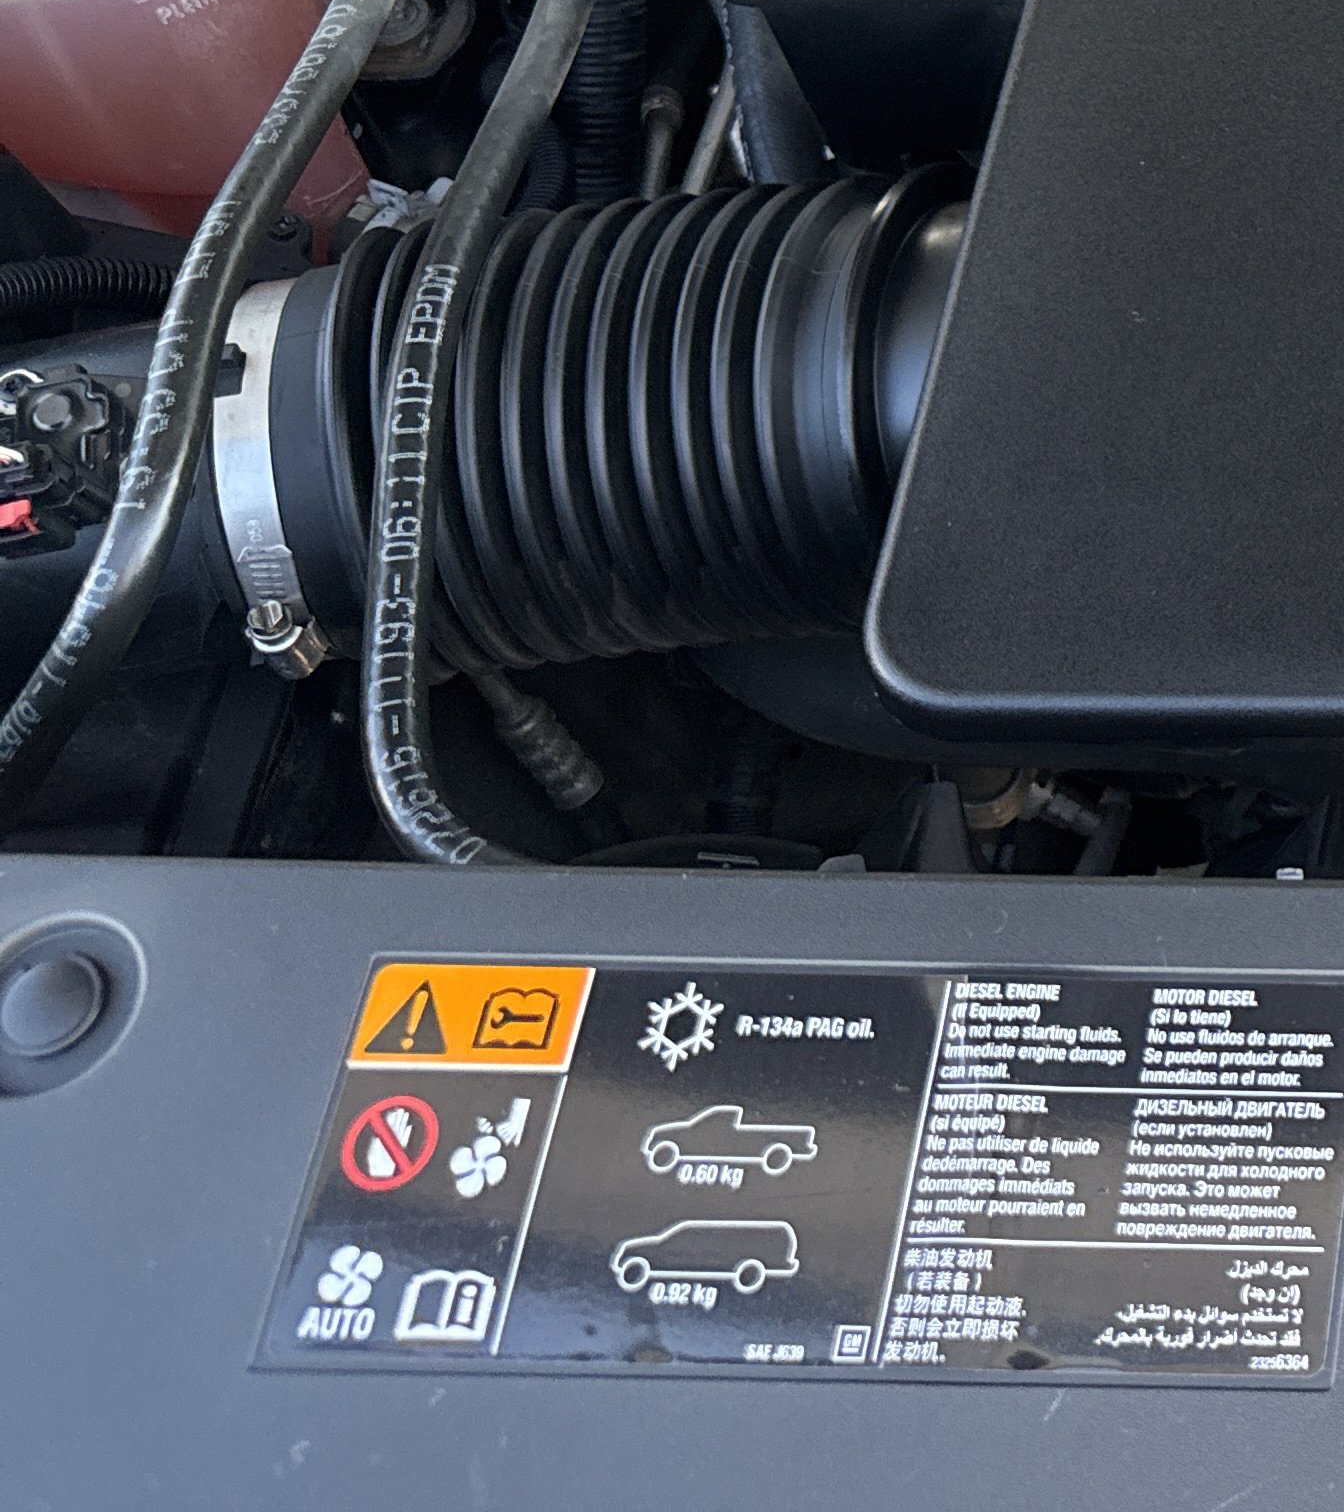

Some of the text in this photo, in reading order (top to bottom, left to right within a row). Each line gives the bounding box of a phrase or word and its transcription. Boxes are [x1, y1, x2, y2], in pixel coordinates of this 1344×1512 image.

[405, 262, 460, 346] EPDM
[956, 983, 1061, 1001] DIESEL ENGINE
[1154, 989, 1257, 1006] MOTOR DIESEL
[970, 1003, 1041, 1022] Equipped)
[1150, 1008, 1232, 1027] (Si lo tiene)
[735, 1016, 876, 1040] R-134a PAG oil.
[949, 1024, 1122, 1045] Do not use starting fluids.
[1147, 1029, 1334, 1051] No use fluidos de arranque.
[945, 1043, 1125, 1064] Immediate engine damage
[1143, 1049, 1324, 1068] Se pueden producir daños
[940, 1063, 1011, 1079] can result.
[1219, 1072, 1238, 1084] en
[1240, 1070, 1255, 1084] el
[1257, 1071, 1302, 1086] motor.
[934, 1095, 1049, 1113] MOTEUR DIESEL
[1135, 1097, 1325, 1121] ДИЗЕЛЬНЫЙ ДВИГАТЕЛЬ
[930, 1114, 1005, 1133] (si équipé)
[1133, 1121, 1273, 1141] (если установлен)
[926, 1134, 1099, 1157] Ne pas utiliser de liquide
[1130, 1141, 1334, 1163] Не используйте пусковые
[1022, 1157, 1050, 1174] Des
[1126, 1162, 1325, 1181] жидкости для холодного
[678, 1164, 744, 1189] 0.60 kg
[918, 1175, 1075, 1196] dommages immédiats
[1122, 1181, 1281, 1199] запуска. Это может
[913, 1198, 1085, 1219] au moteur pourraient en
[1119, 1203, 1296, 1221] вызвать немедленное
[909, 1216, 966, 1234] résulter.
[1116, 1222, 1315, 1240] повреждение двигателя.
[904, 1248, 992, 1270] 柴油发动机
[1226, 1259, 1309, 1279] محرك الديزل
[648, 1282, 718, 1308] 0.92 kg
[298, 1308, 376, 1340] AUTO
[1199, 1305, 1239, 1325] سوائل
[1241, 1307, 1289, 1326] تستخدم
[1291, 1308, 1304, 1324] لا
[889, 1317, 1020, 1342] 否则会立即损坏
[1155, 1325, 1194, 1348] فورية
[1240, 1329, 1277, 1346] تحدث
[1279, 1329, 1300, 1346] فقد
[842, 1333, 862, 1347] GM
[743, 1343, 773, 1361] SAE
[1248, 1353, 1309, 1371] 23256364
